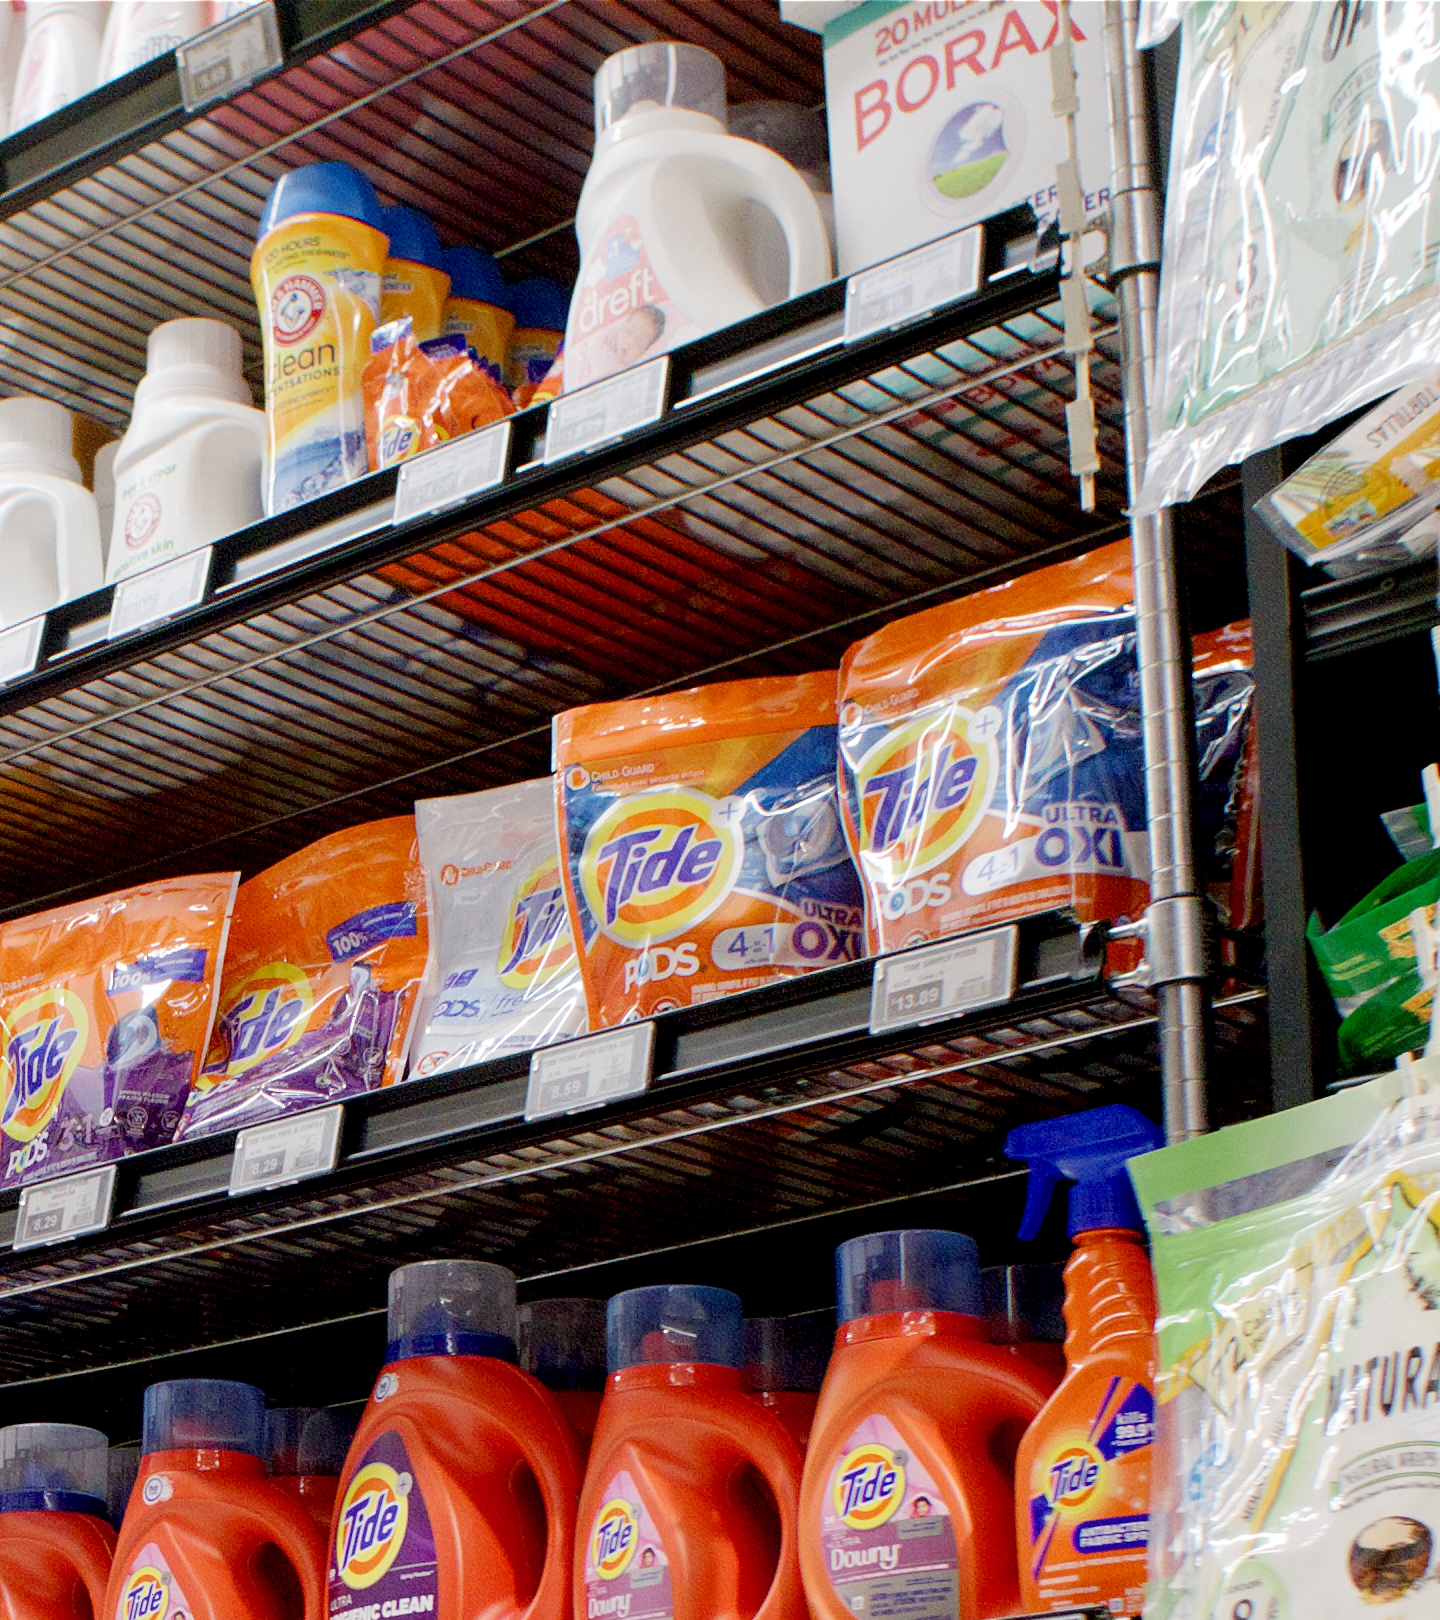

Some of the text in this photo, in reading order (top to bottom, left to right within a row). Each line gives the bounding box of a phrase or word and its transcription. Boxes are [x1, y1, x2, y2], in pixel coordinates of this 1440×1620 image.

[872, 25, 910, 55] 20
[852, 0, 1088, 153] BORAX
[578, 265, 656, 336] dreft
[270, 341, 336, 385] clean
[1366, 388, 1440, 450] TORTILLAS
[863, 742, 979, 850] Tide
[1042, 803, 1119, 826] ULTRA
[1033, 824, 1121, 869] OXI
[595, 825, 722, 926] Tide
[802, 899, 861, 927] ULTRA
[331, 928, 373, 956] 100%
[622, 942, 701, 994] PODS
[0, 1013, 81, 1127] Tide
[839, 1465, 896, 1516] Tide
[1049, 1456, 1100, 1504] Tide
[339, 1498, 399, 1575] Tide
[595, 1516, 633, 1580] Tide
[829, 1541, 902, 1573] Downy
[382, 1594, 435, 1618] CLEAN
[587, 1592, 633, 1620] Downy
